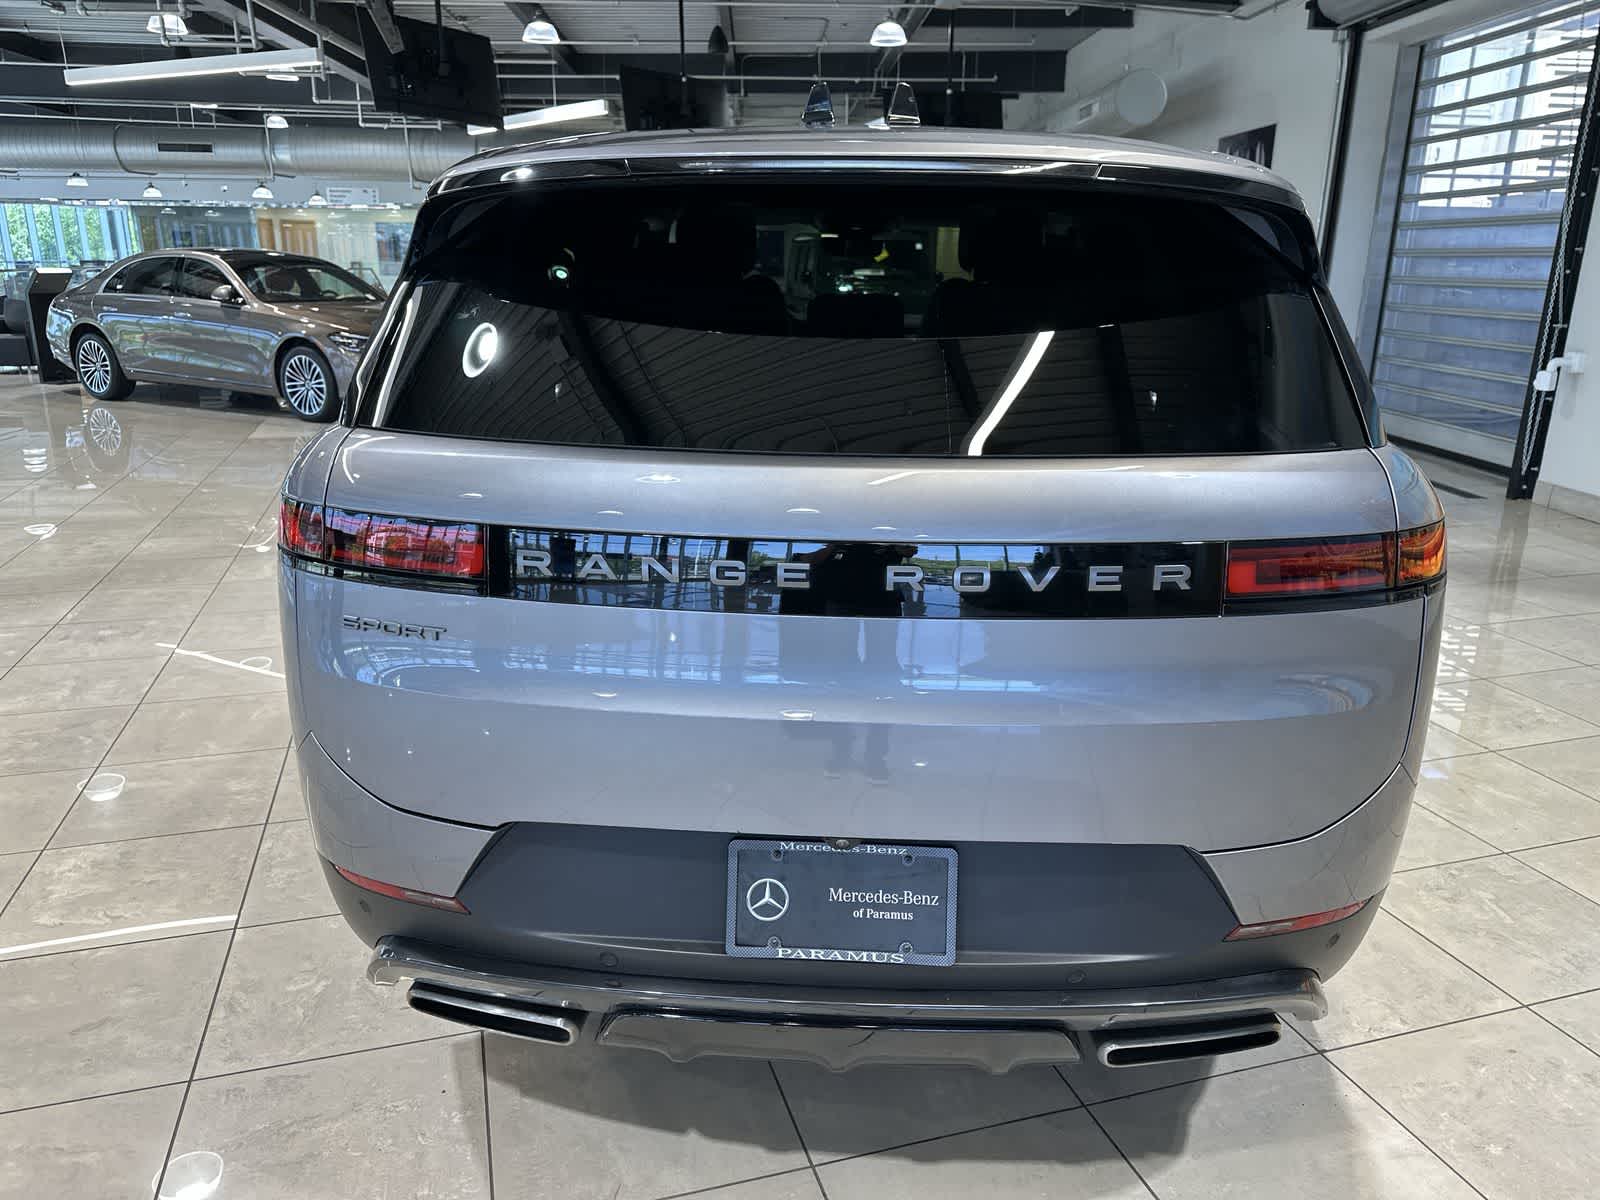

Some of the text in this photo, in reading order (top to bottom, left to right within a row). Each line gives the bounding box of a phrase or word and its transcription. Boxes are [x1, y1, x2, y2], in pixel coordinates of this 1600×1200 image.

[516, 549, 1193, 593] RANGE ROVER
[342, 614, 447, 642] SPORT
[828, 887, 939, 907] Mercedes-Benz
[853, 908, 914, 921] of Paramus
[776, 948, 905, 964] PARAMUS
